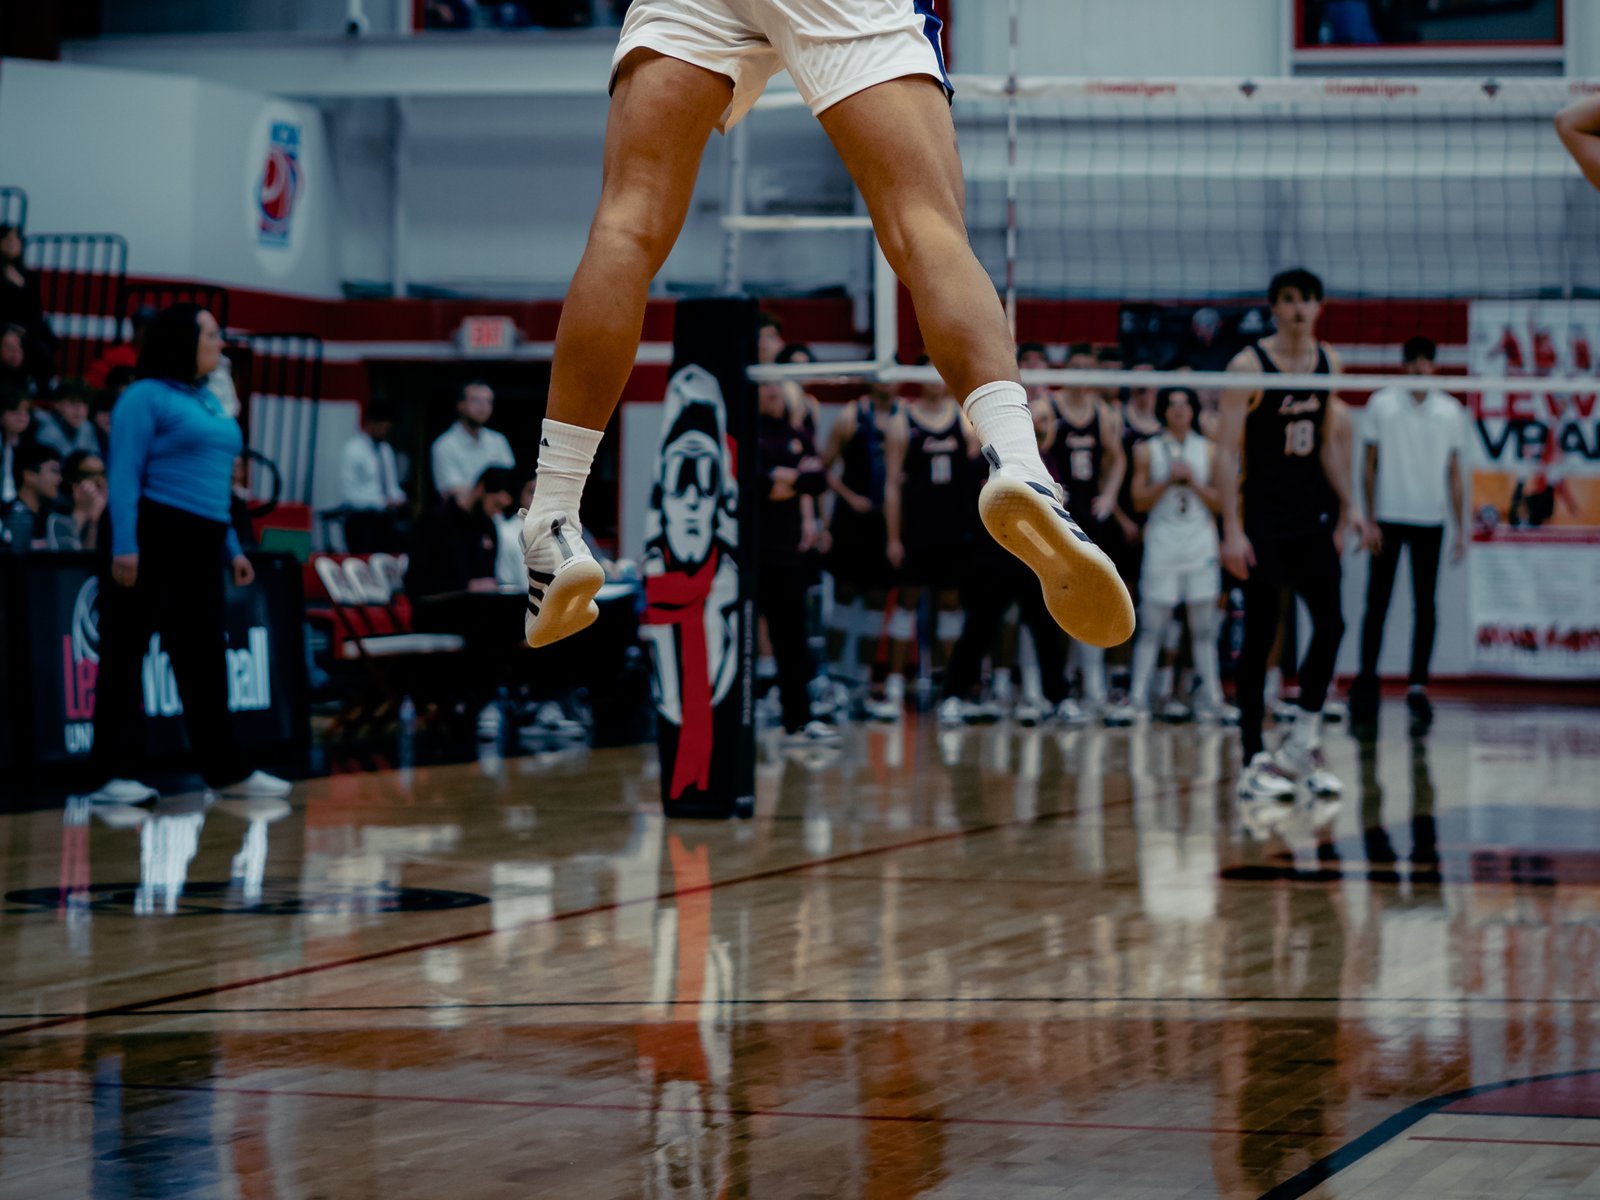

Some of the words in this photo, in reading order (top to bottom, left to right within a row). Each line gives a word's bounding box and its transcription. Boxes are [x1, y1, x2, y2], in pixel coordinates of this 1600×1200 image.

[471, 320, 504, 347] EXIT
[1284, 419, 1314, 456] 18
[1474, 419, 1600, 459] VBA
